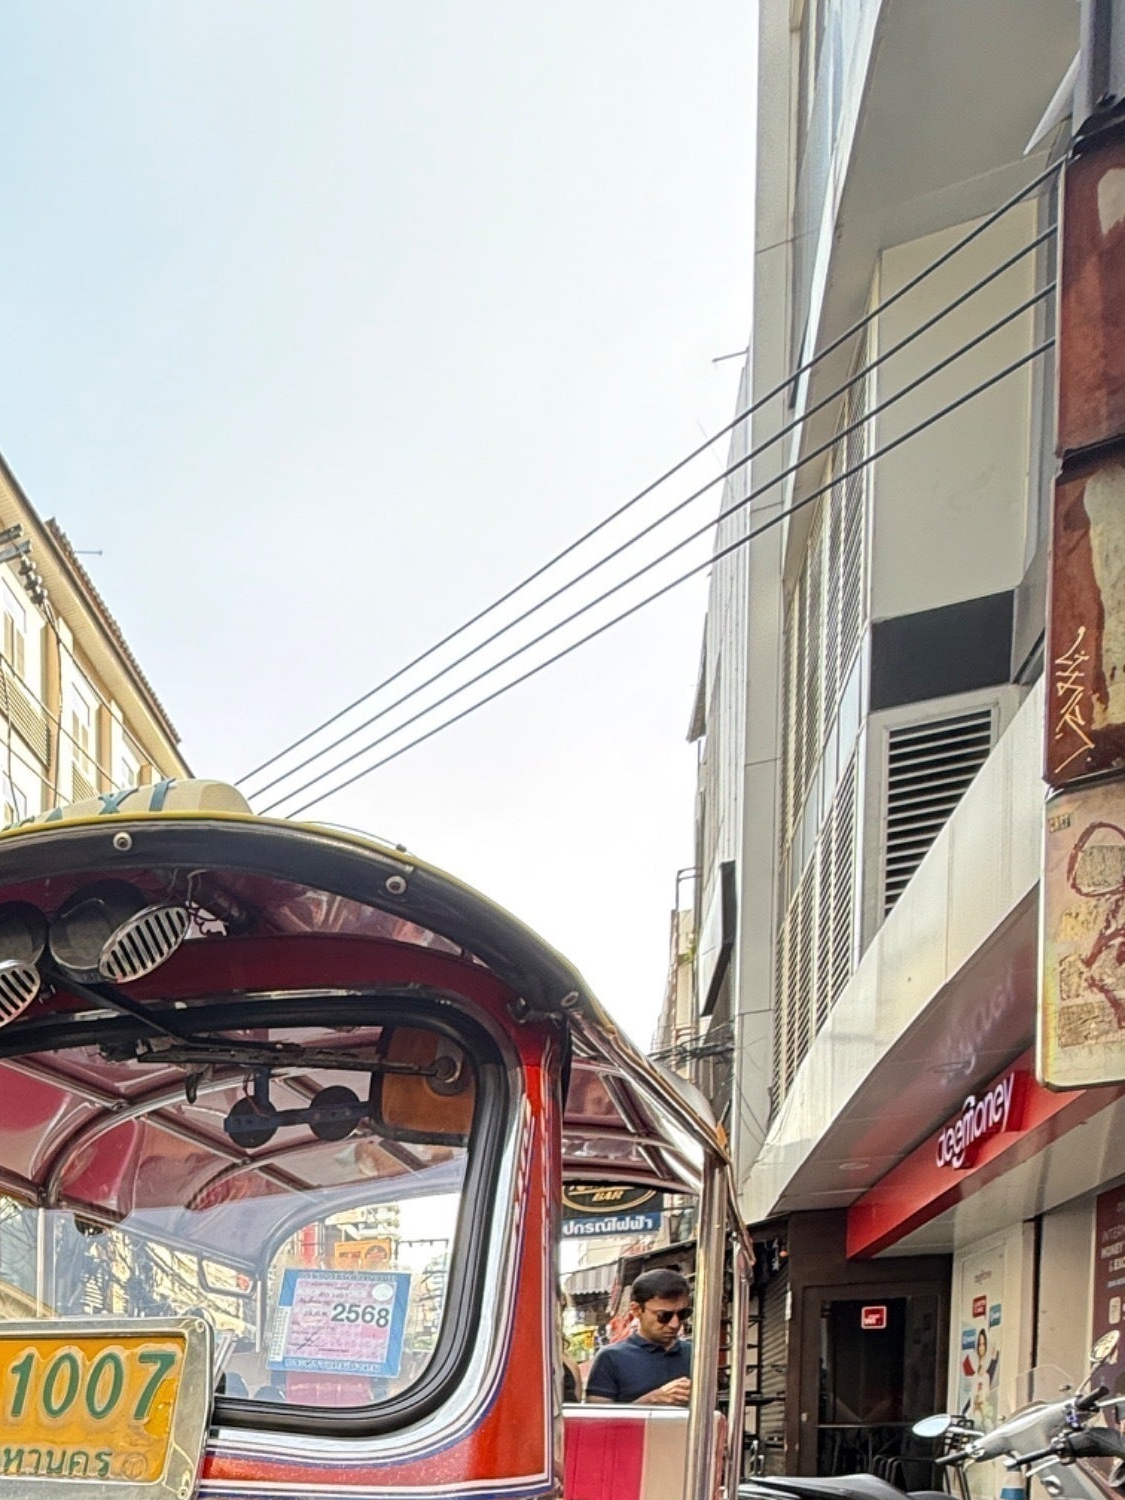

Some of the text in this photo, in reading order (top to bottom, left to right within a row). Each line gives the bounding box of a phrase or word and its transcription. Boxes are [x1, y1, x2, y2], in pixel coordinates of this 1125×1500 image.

[936, 1072, 1015, 1169] deemoney
[331, 1303, 390, 1328] 2568
[9, 1350, 177, 1421] 1007
